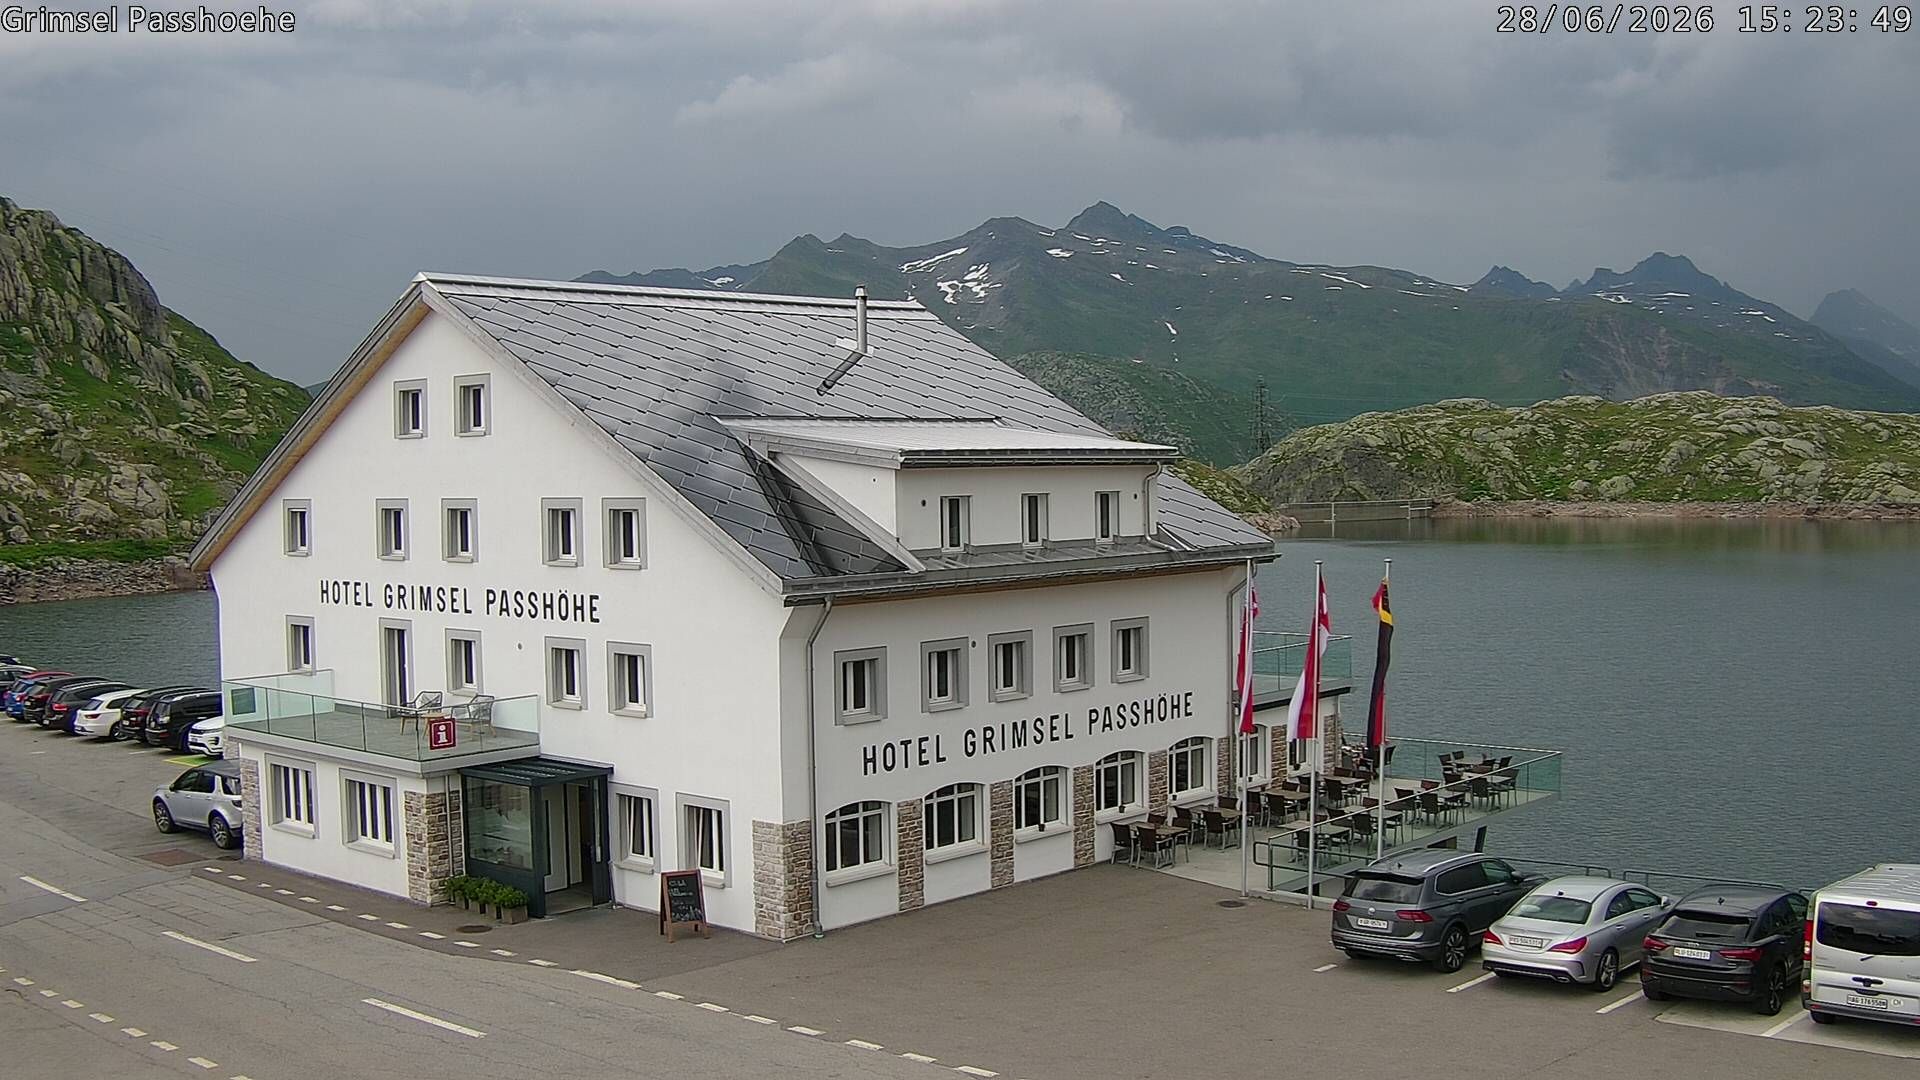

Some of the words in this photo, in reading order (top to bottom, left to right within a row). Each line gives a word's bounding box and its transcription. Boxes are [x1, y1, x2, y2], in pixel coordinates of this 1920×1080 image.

[320, 579, 373, 607] HOTEL
[384, 584, 473, 614] GRIMSEL
[486, 588, 600, 623] PASSHÖHE
[863, 734, 947, 776] HOTEL
[964, 712, 1074, 758] GRIMSEL
[1088, 691, 1193, 736] PASSHÖHE
